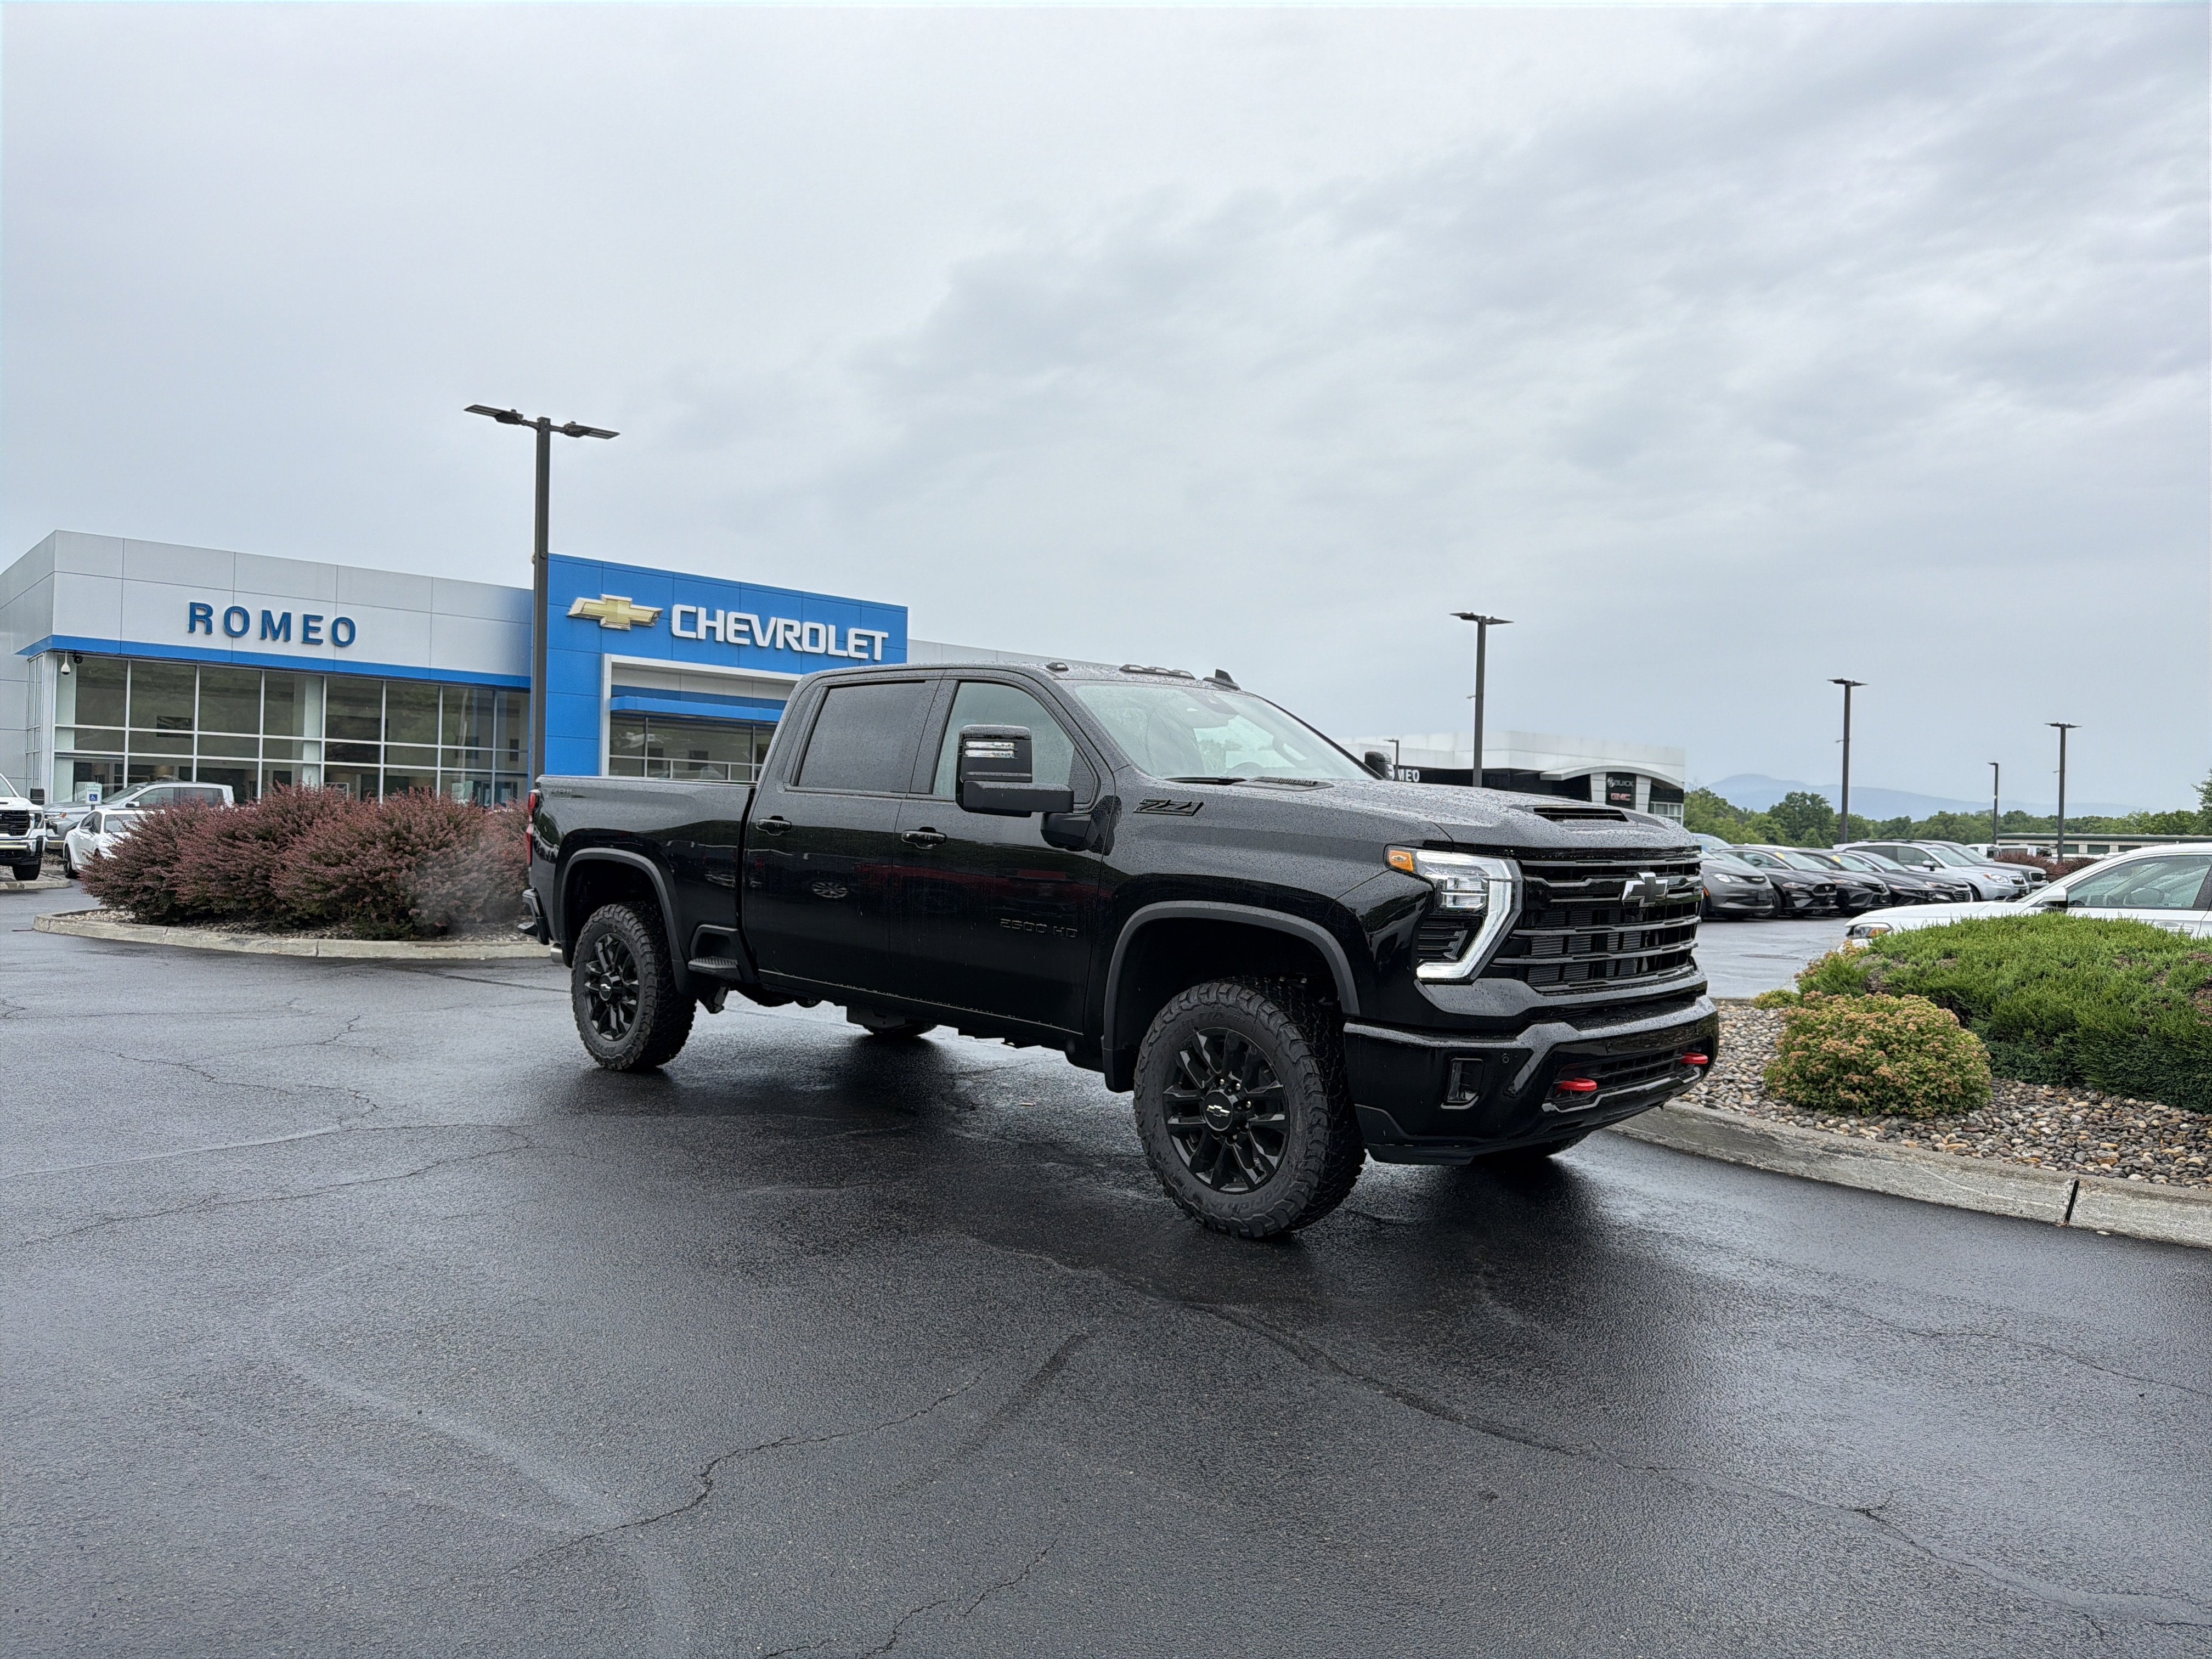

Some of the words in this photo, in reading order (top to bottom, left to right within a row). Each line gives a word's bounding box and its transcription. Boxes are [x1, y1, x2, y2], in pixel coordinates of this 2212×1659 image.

[188, 602, 356, 647] ROMEO
[672, 604, 889, 661] CHEVROLET
[1397, 768, 1420, 782] MEO
[1610, 793, 1630, 801] GMC
[1000, 918, 1047, 933] 2500
[1053, 926, 1078, 938] HD
